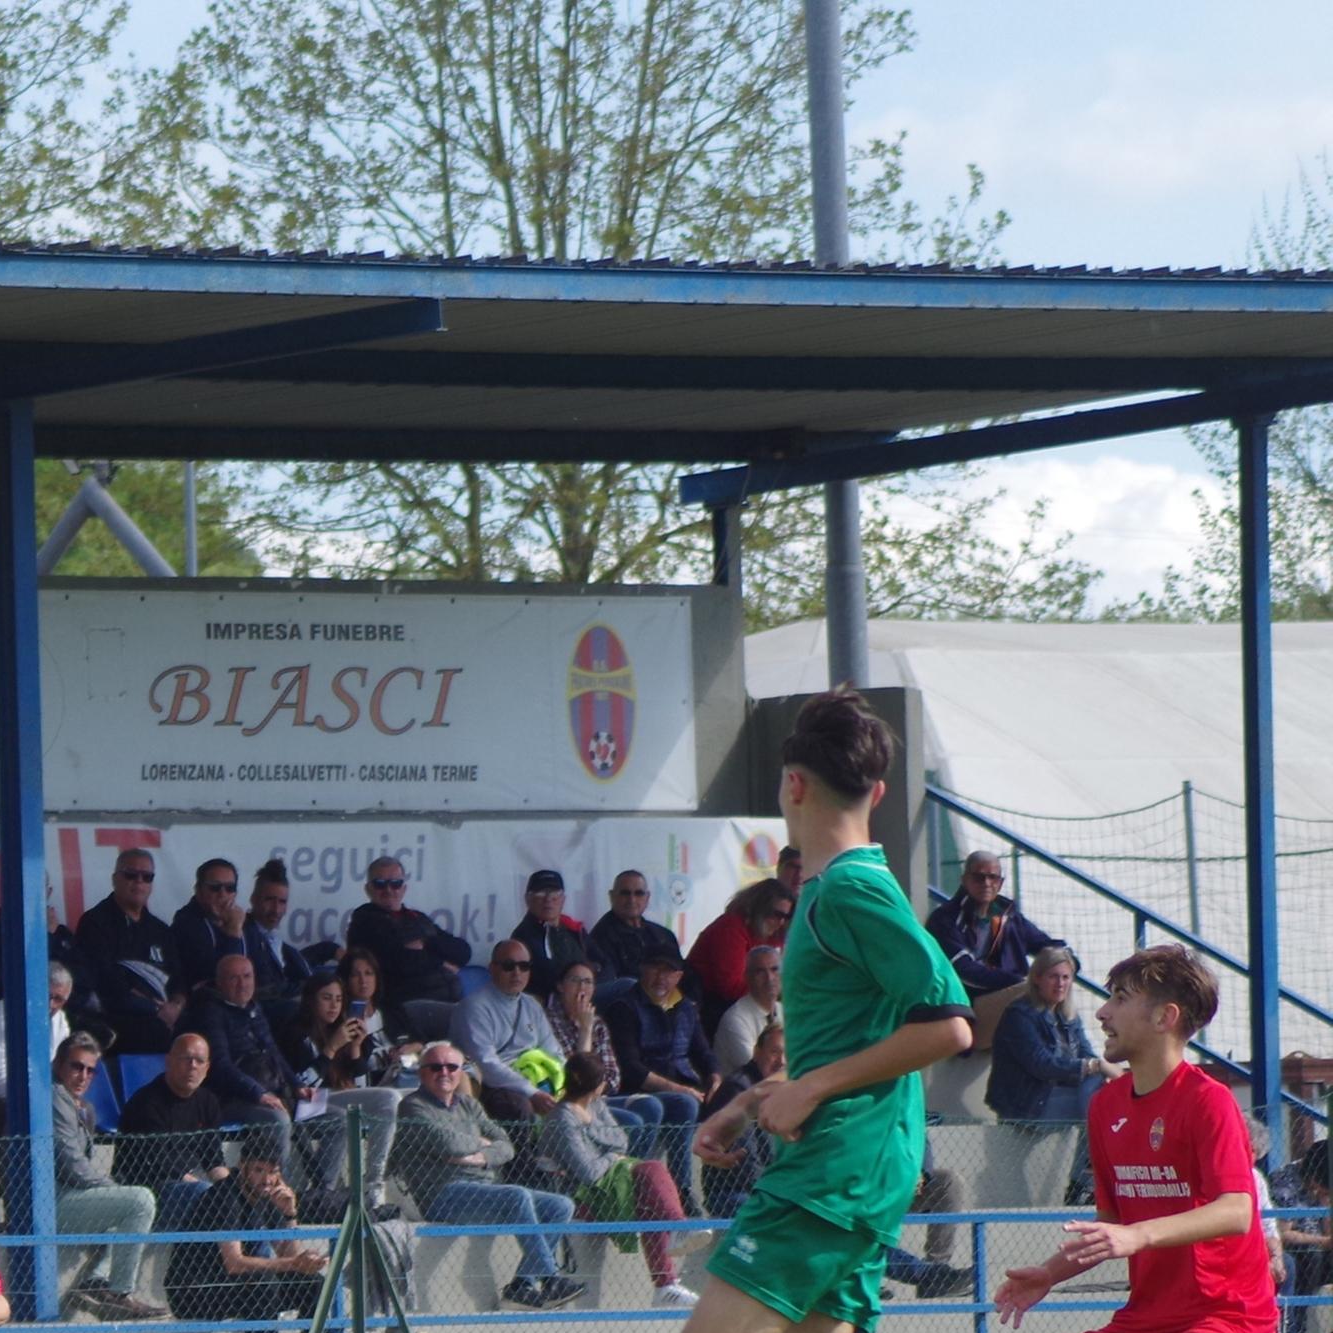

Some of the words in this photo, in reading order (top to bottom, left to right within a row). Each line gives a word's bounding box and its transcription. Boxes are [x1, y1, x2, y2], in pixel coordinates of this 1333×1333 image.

[205, 622, 303, 641] IMPRESA
[310, 624, 405, 642] FUNEBRE
[148, 663, 464, 737] BIASCI
[141, 764, 225, 782] LORENZANA
[237, 764, 347, 782] COLLESALVETTI
[358, 765, 430, 782] CASCIANA
[432, 764, 478, 782] TERME
